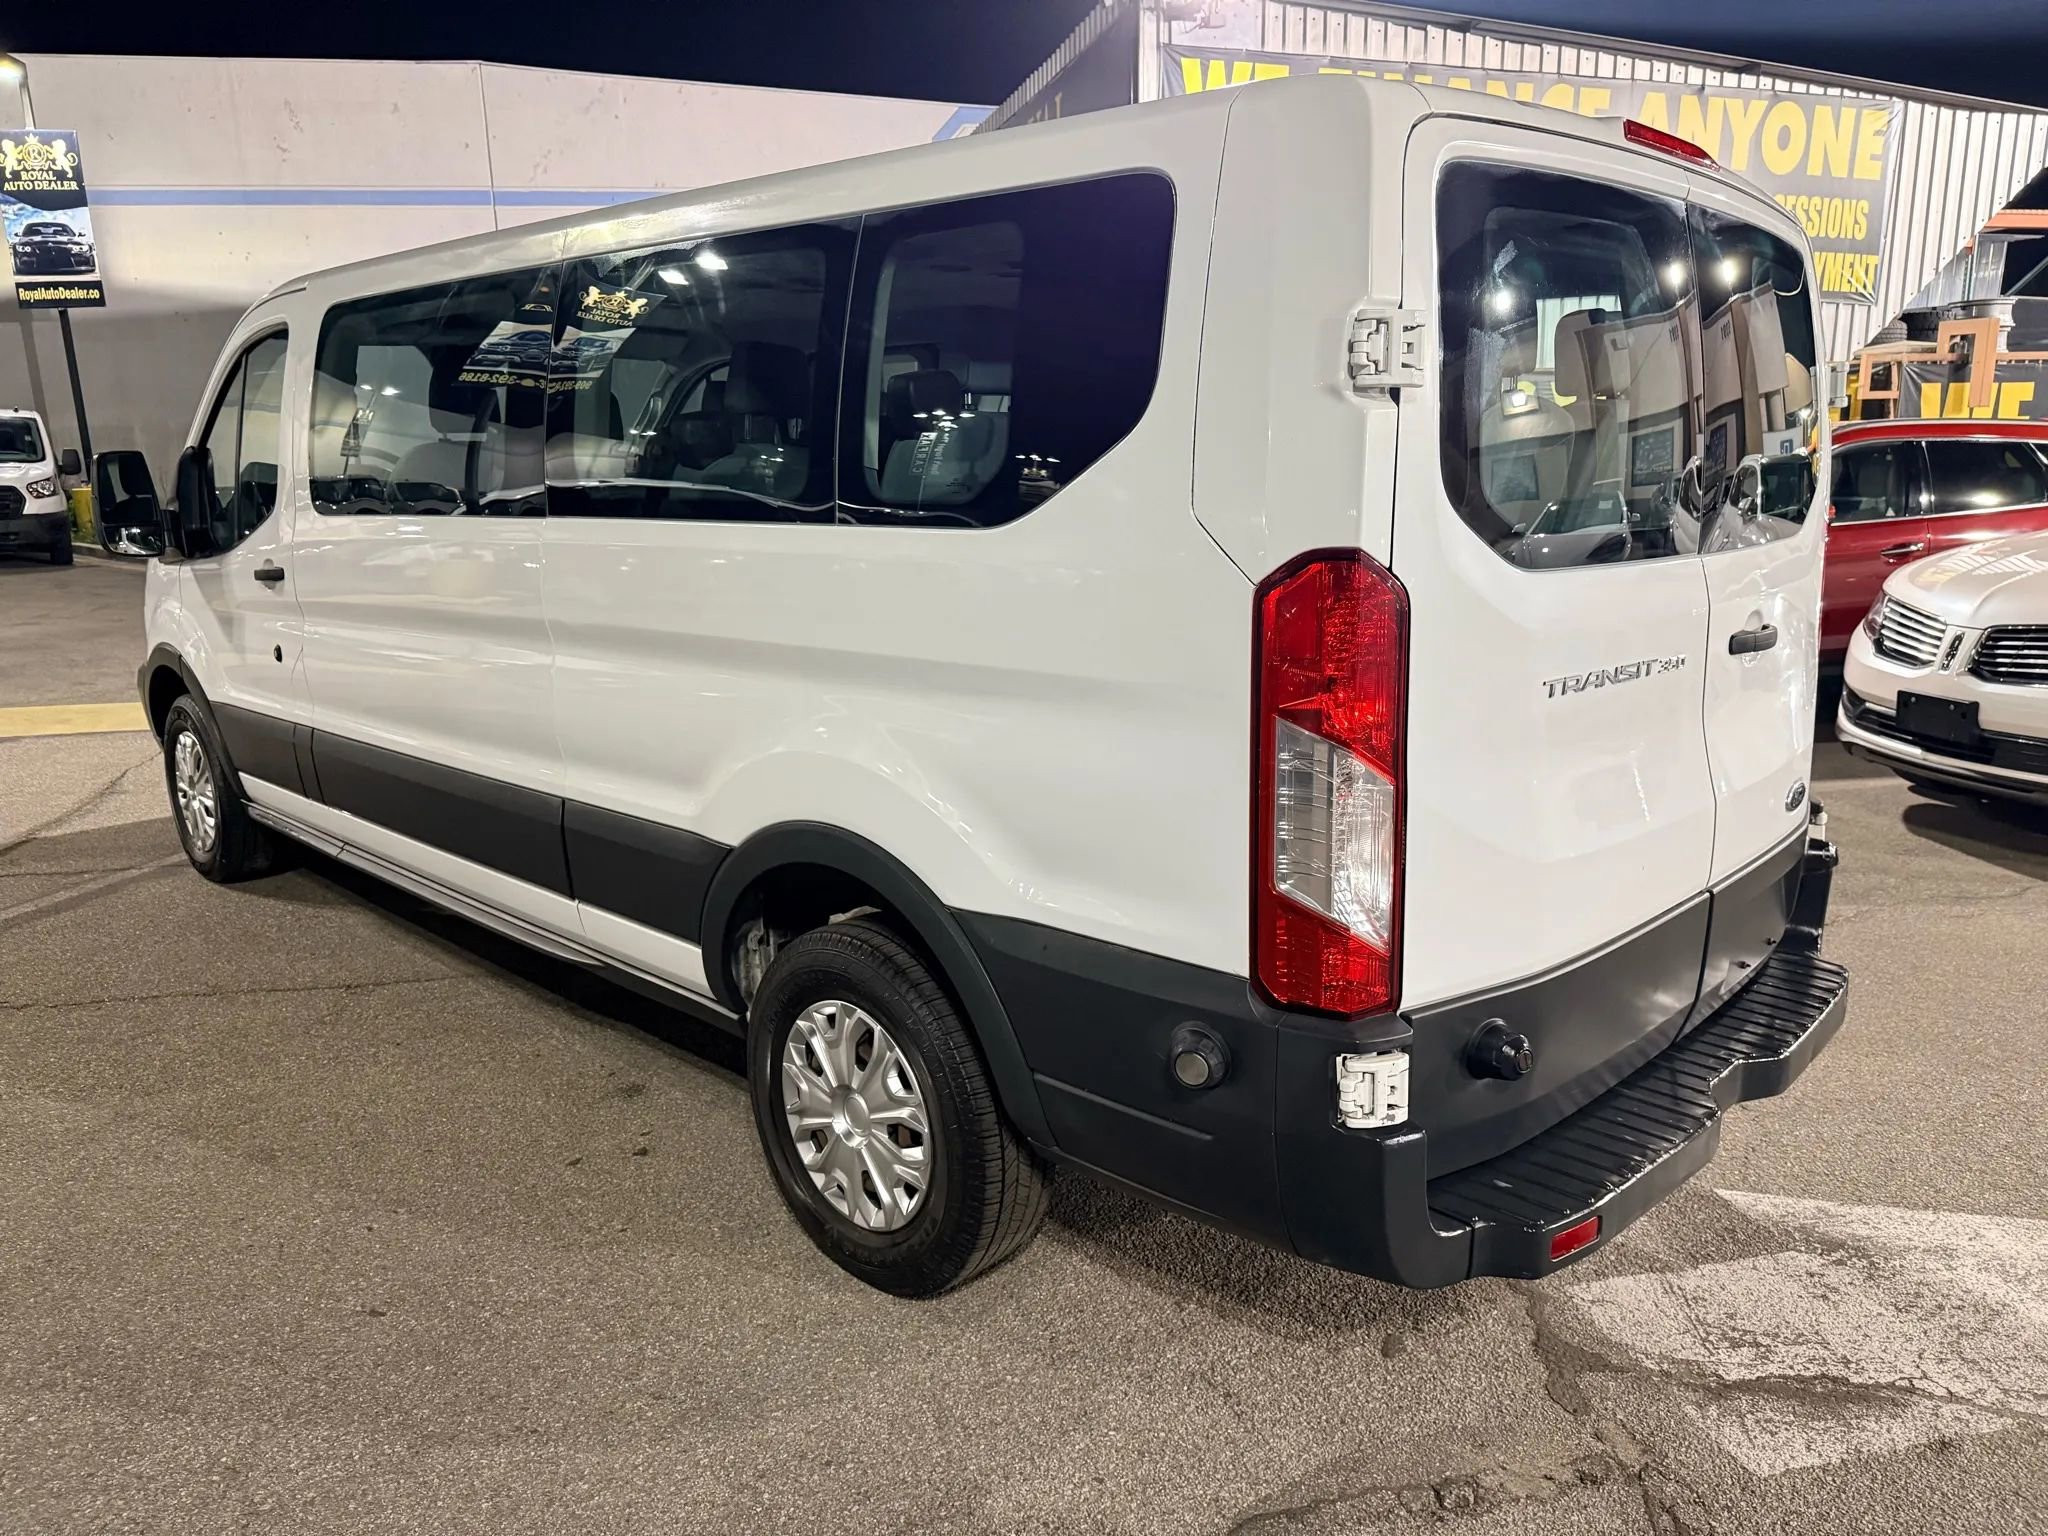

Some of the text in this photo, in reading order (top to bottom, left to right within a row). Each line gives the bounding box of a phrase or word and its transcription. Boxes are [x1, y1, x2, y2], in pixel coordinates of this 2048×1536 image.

[1638, 91, 1890, 181] ANYONE
[21, 170, 57, 180] ROYAL
[3, 181, 79, 191] AUTO DEALER
[18, 286, 100, 302] RoyalAutoDealer.co
[1543, 658, 1659, 698] TRANSIT
